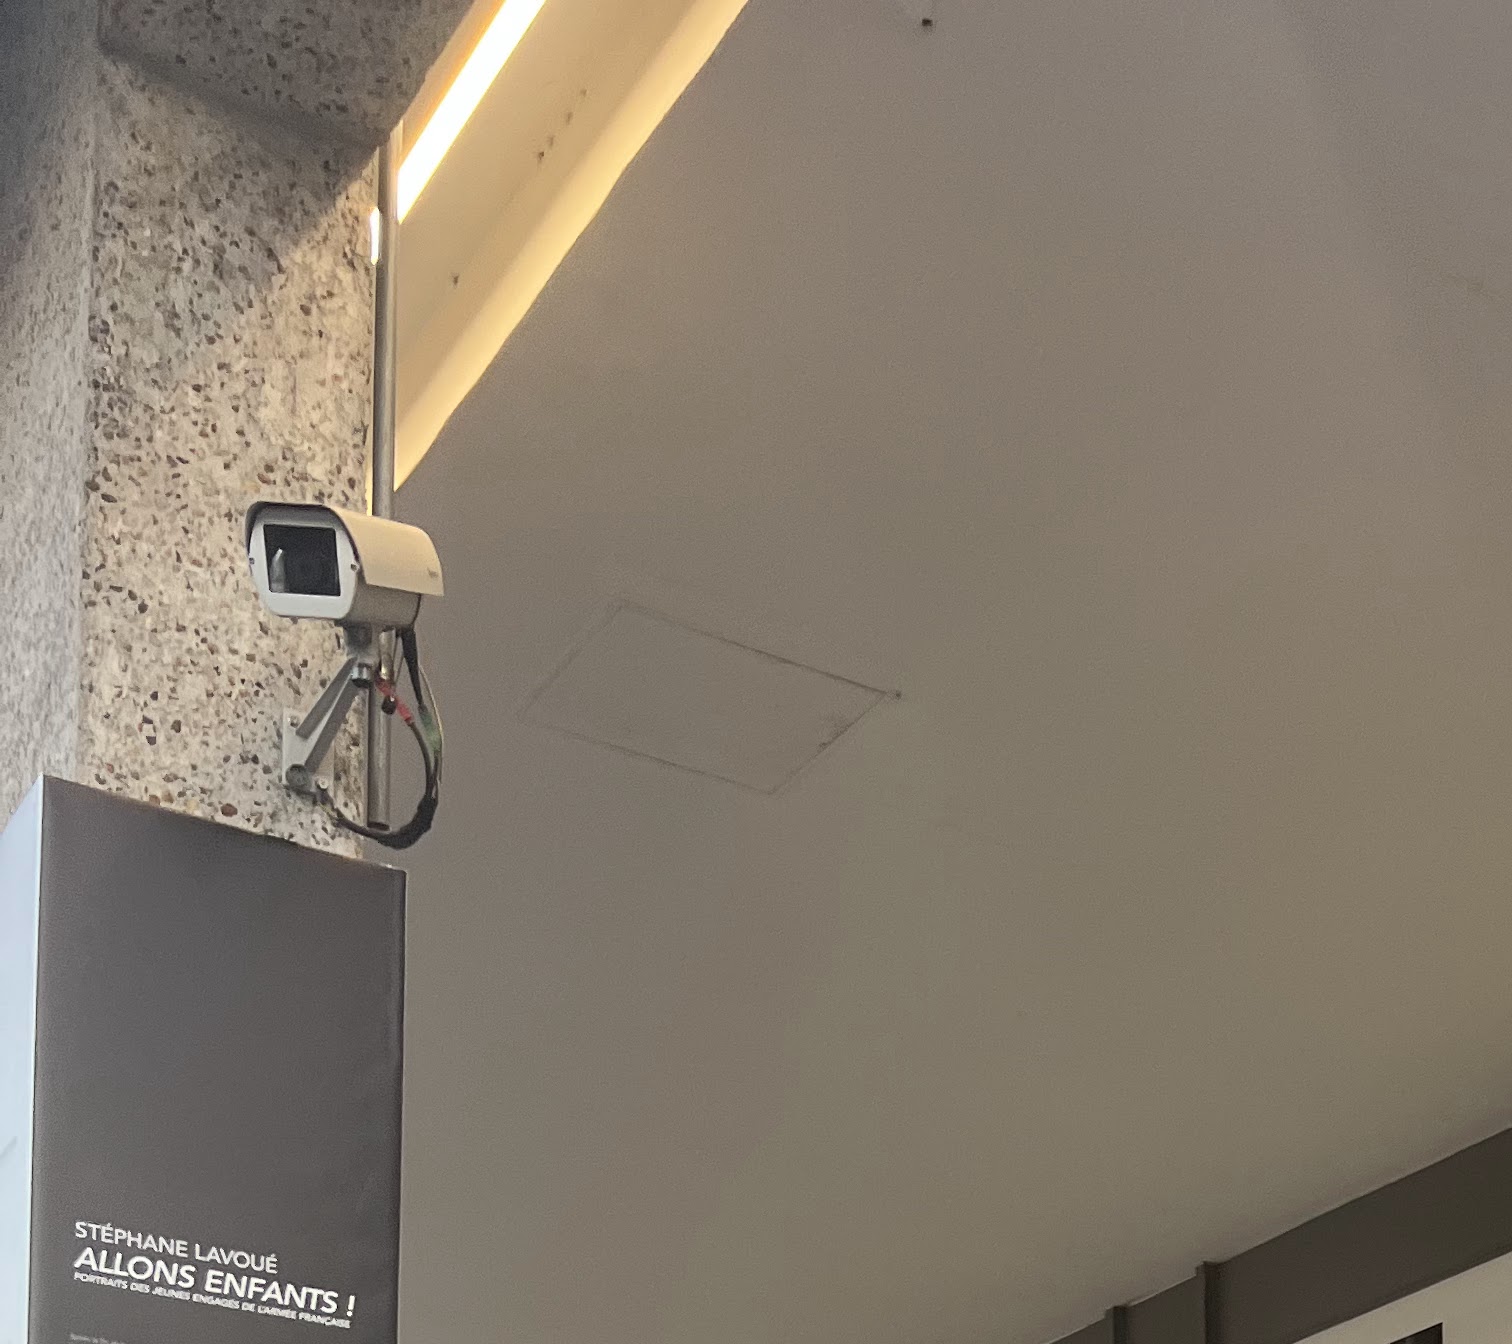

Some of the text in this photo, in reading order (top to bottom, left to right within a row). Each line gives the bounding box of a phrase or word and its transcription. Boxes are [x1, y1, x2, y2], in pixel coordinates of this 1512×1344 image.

[74, 1221, 278, 1274] STÉPHANE LAVOUÉ
[74, 1246, 195, 1289] ALLONS
[204, 1269, 338, 1314] ENFANTS
